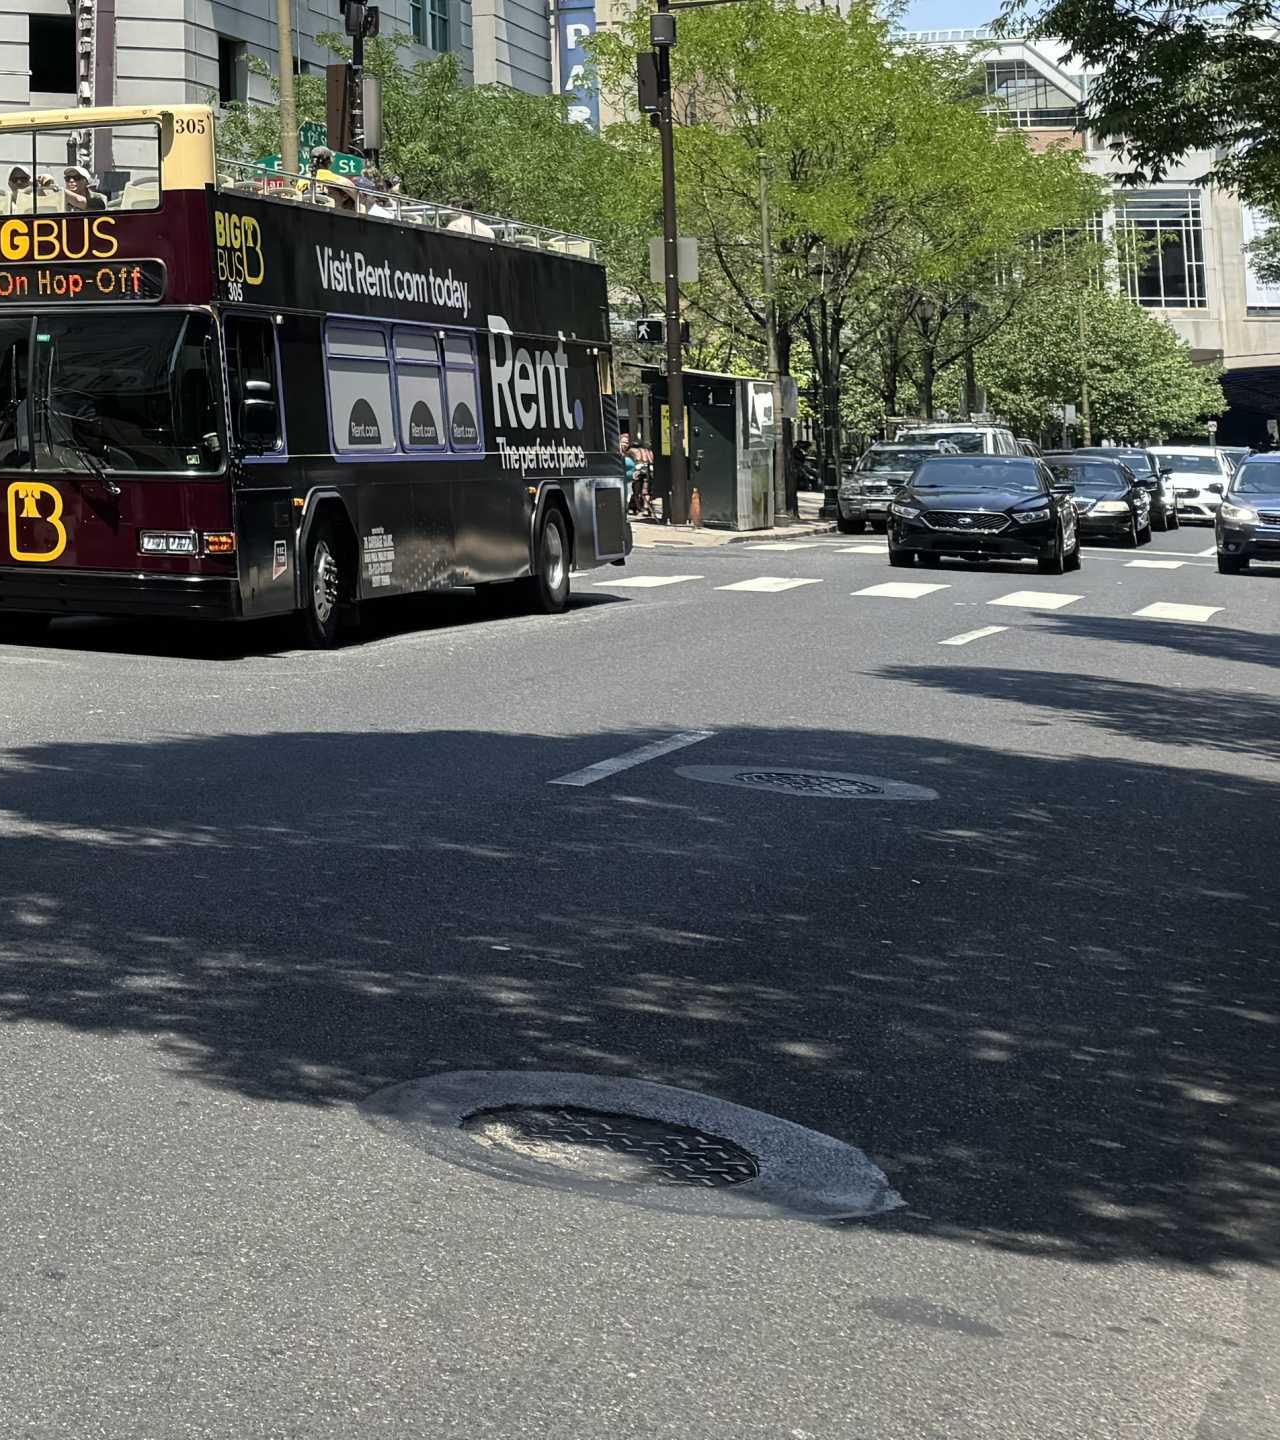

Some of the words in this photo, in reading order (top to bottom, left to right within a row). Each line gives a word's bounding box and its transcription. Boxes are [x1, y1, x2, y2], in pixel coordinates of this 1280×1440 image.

[174, 117, 207, 136] 305
[338, 161, 356, 174] St
[214, 210, 241, 250] BIG
[216, 247, 245, 283] BUS
[38, 265, 142, 298] Hop-Off
[227, 280, 244, 302] 305
[315, 244, 353, 294] Visit
[354, 250, 429, 304] Rent.com
[429, 267, 472, 319] today.
[350, 421, 379, 438] Rent.com
[410, 422, 436, 437] Rent.com
[495, 436, 521, 470] The
[520, 437, 559, 478] perfect
